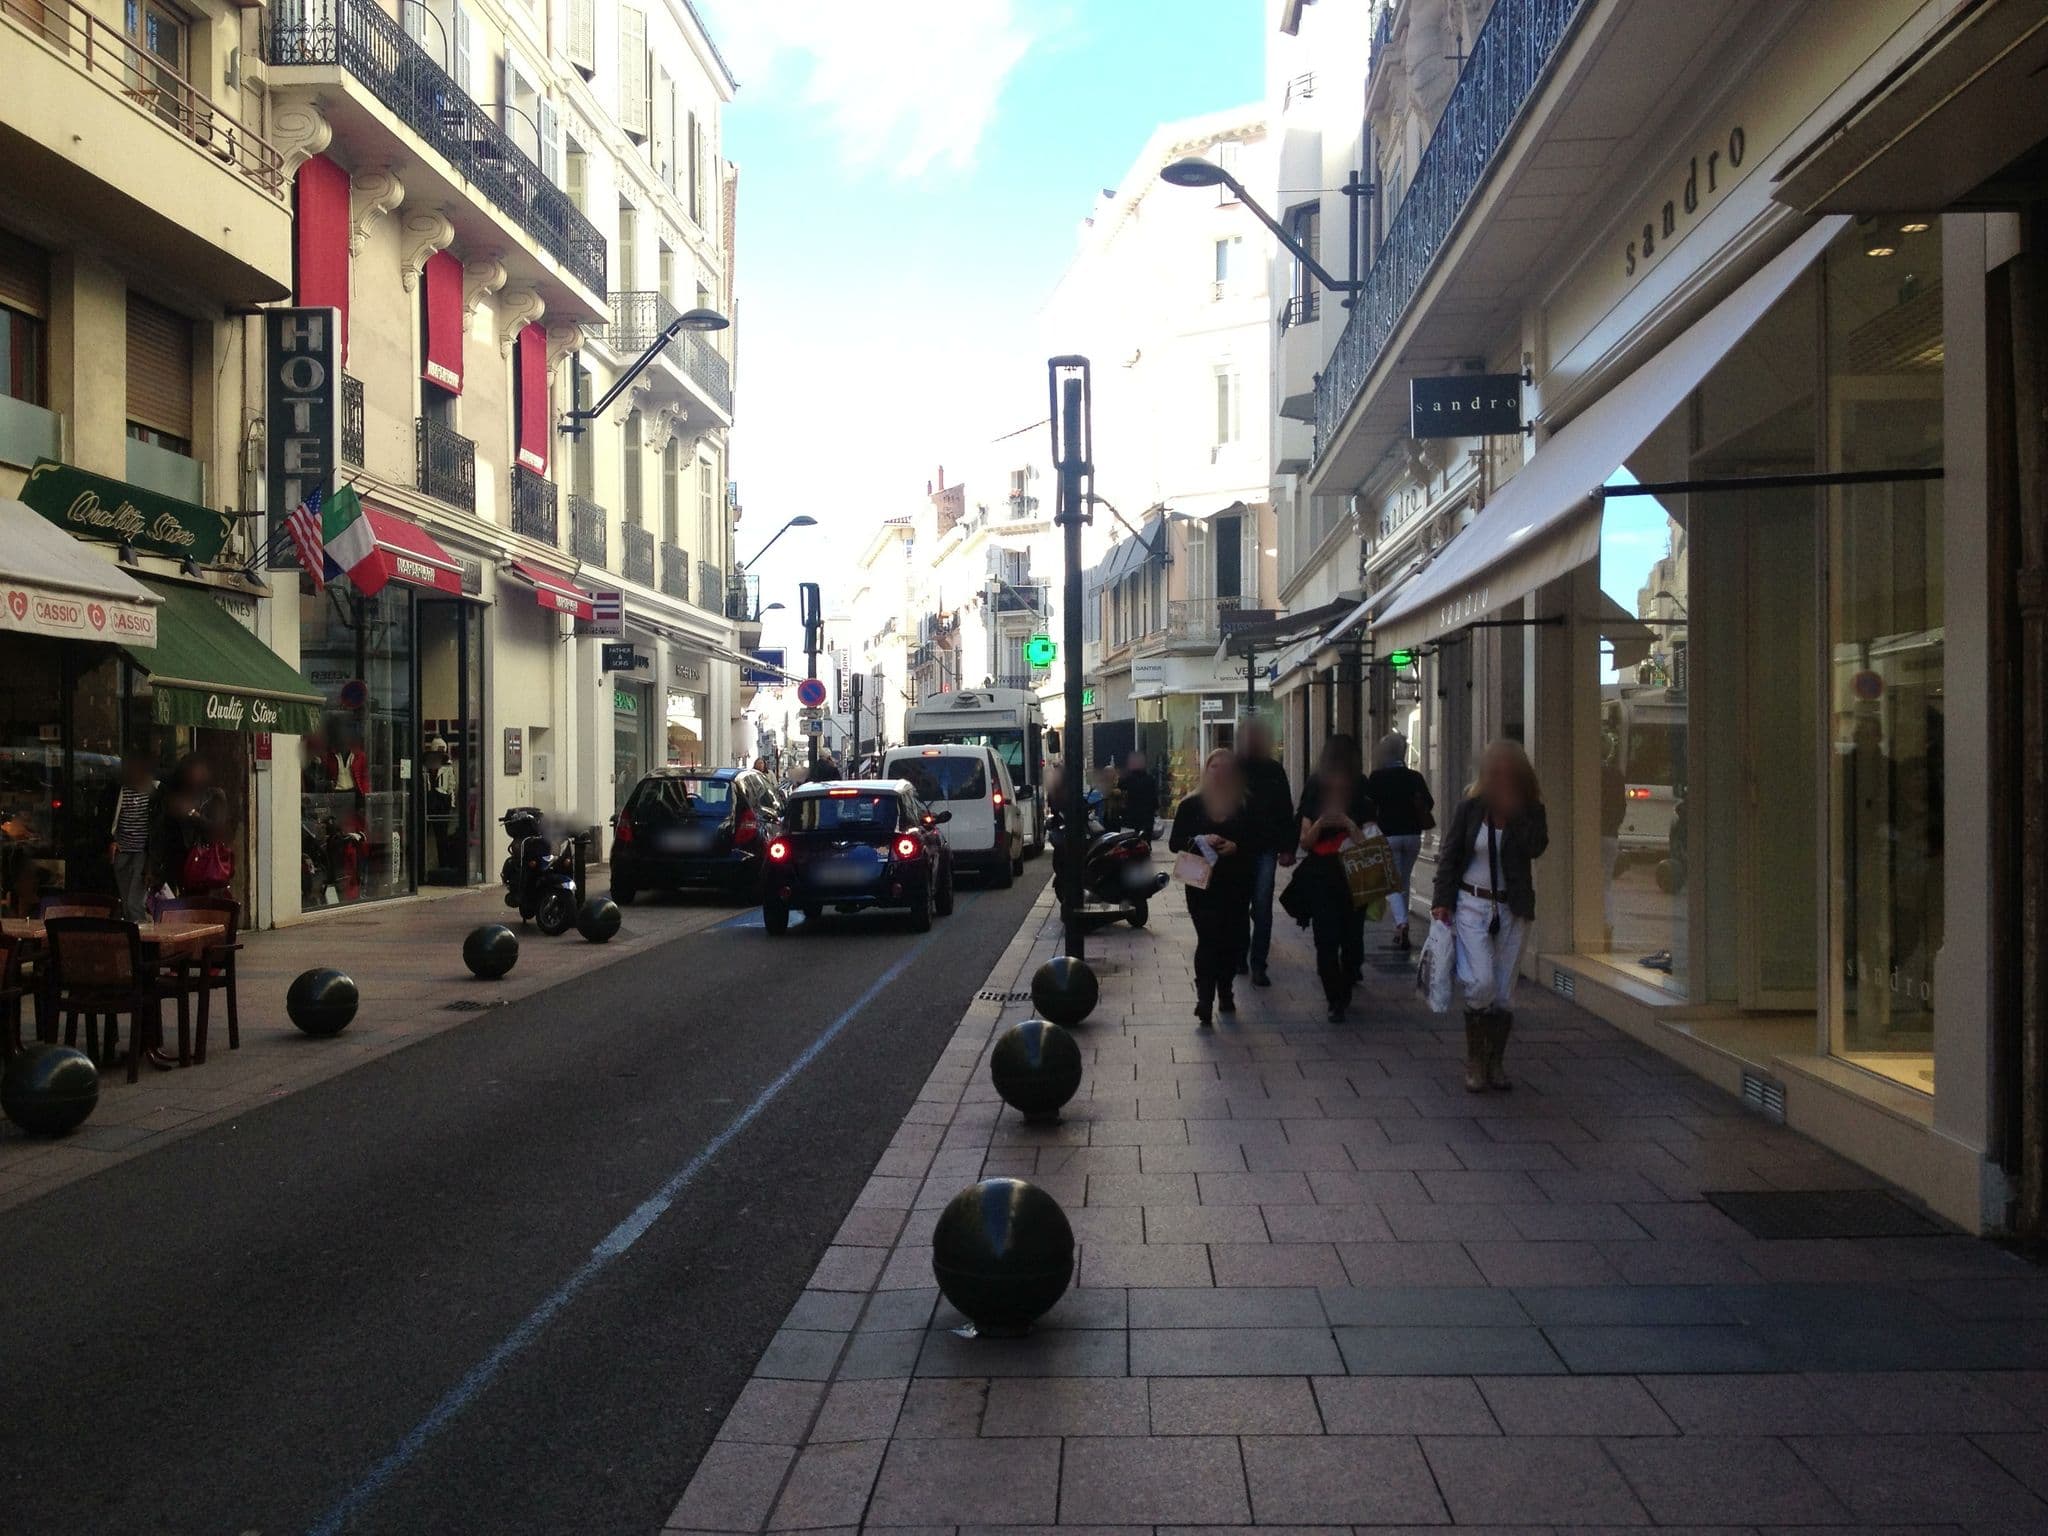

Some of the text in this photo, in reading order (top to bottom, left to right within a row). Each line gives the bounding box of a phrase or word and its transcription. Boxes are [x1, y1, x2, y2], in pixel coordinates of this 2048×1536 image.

[1625, 126, 1746, 278] sandro
[1415, 396, 1517, 413] sandro
[67, 489, 197, 547] Quality Store
[1379, 488, 1418, 541] sandro
[35, 602, 78, 623] CASSIO
[1440, 587, 1489, 628] sandro
[206, 693, 278, 731] Quality Store
